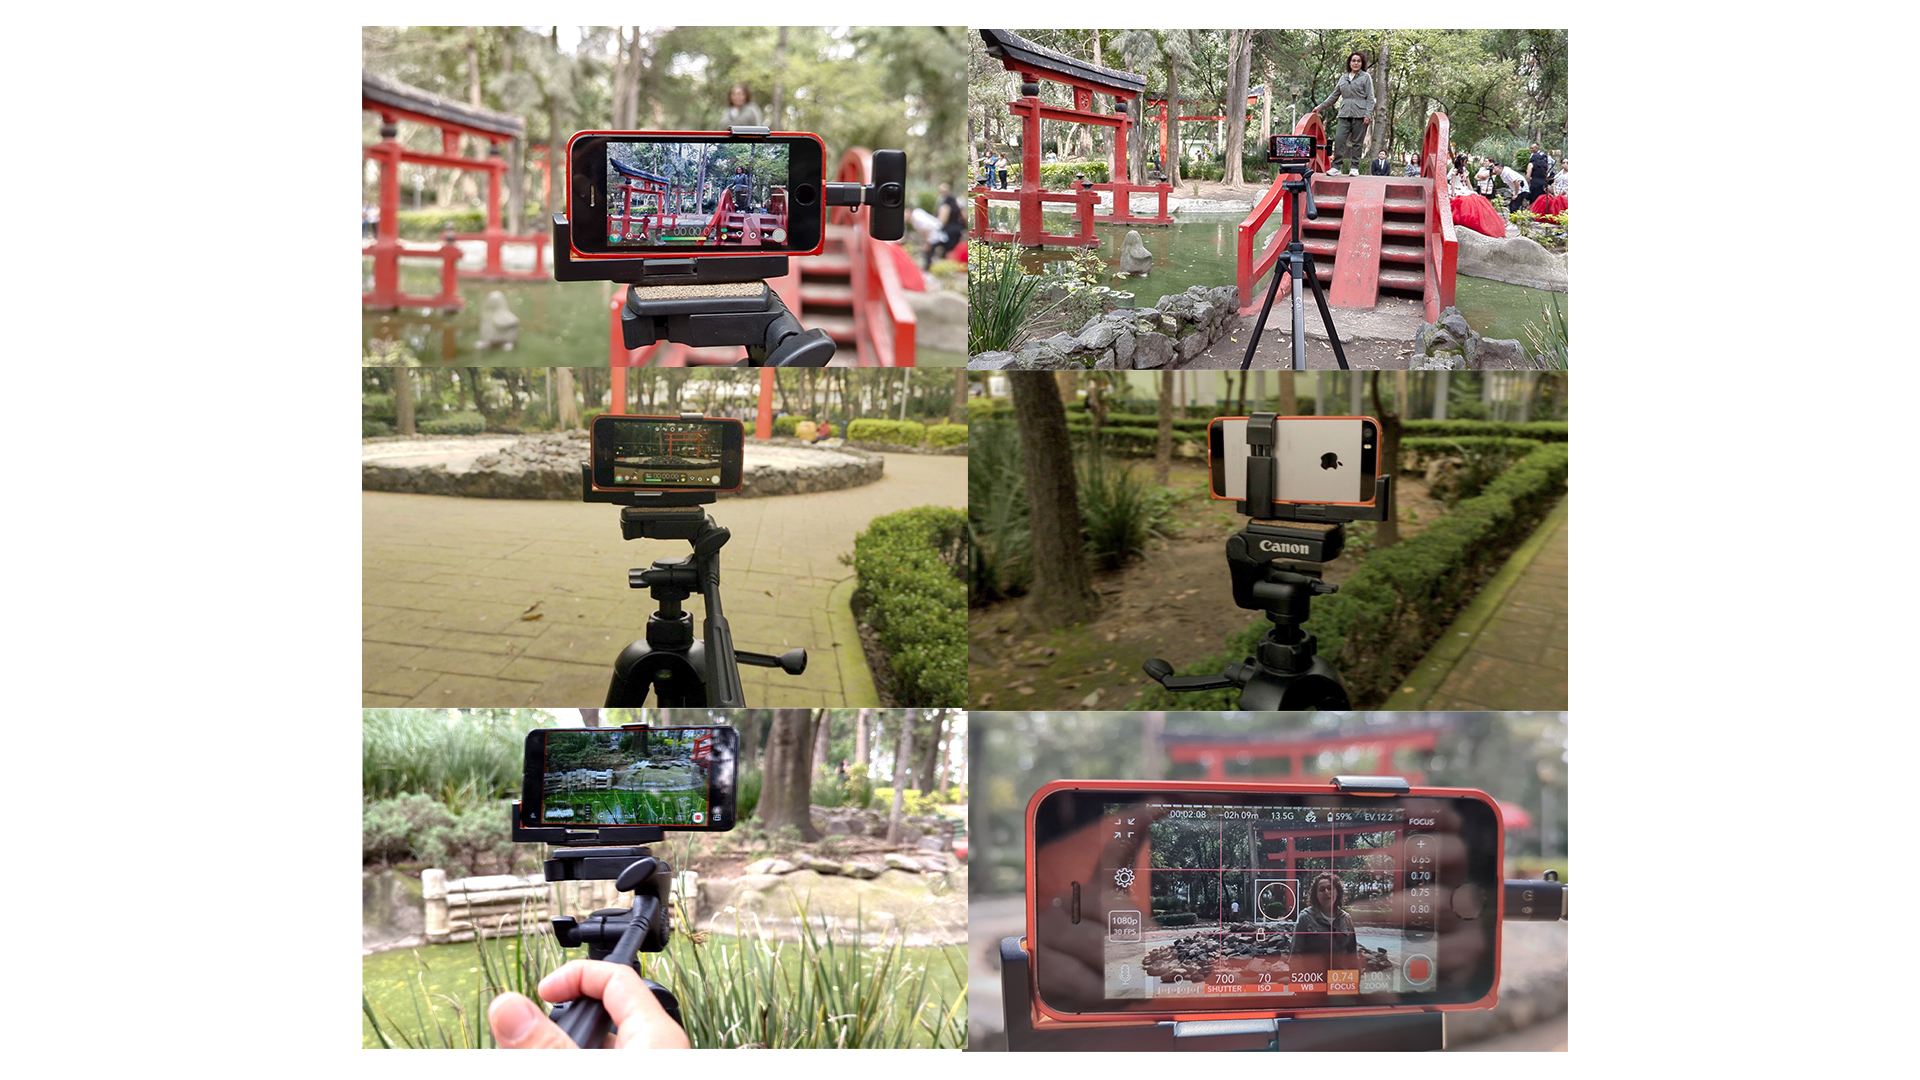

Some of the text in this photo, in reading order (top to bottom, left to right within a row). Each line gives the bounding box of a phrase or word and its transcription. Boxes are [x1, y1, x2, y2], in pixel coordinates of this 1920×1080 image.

[1259, 539, 1310, 555] Canon
[1169, 809, 1207, 819] 00:02:08
[1241, 811, 1259, 820] 09m
[1271, 811, 1295, 820] 13.5G
[1335, 812, 1353, 821] 59%
[1408, 818, 1435, 826] FOCUS
[1410, 871, 1431, 880] 0.70
[1410, 888, 1430, 897] 0.75
[1410, 904, 1430, 914] 0.80
[1112, 916, 1138, 925] 1080p
[1113, 928, 1137, 936] 30 FPS
[1215, 973, 1235, 984] 700
[1258, 973, 1272, 983] 70
[1291, 972, 1324, 983] 5200K
[1332, 972, 1354, 982] 0.74
[1363, 971, 1383, 982] 1.00
[1207, 985, 1242, 993] SHUTTER
[1257, 984, 1272, 992] ISO
[1300, 983, 1314, 991] WB
[1329, 982, 1356, 990] FOCUS
[1364, 982, 1389, 990] ZOOM
